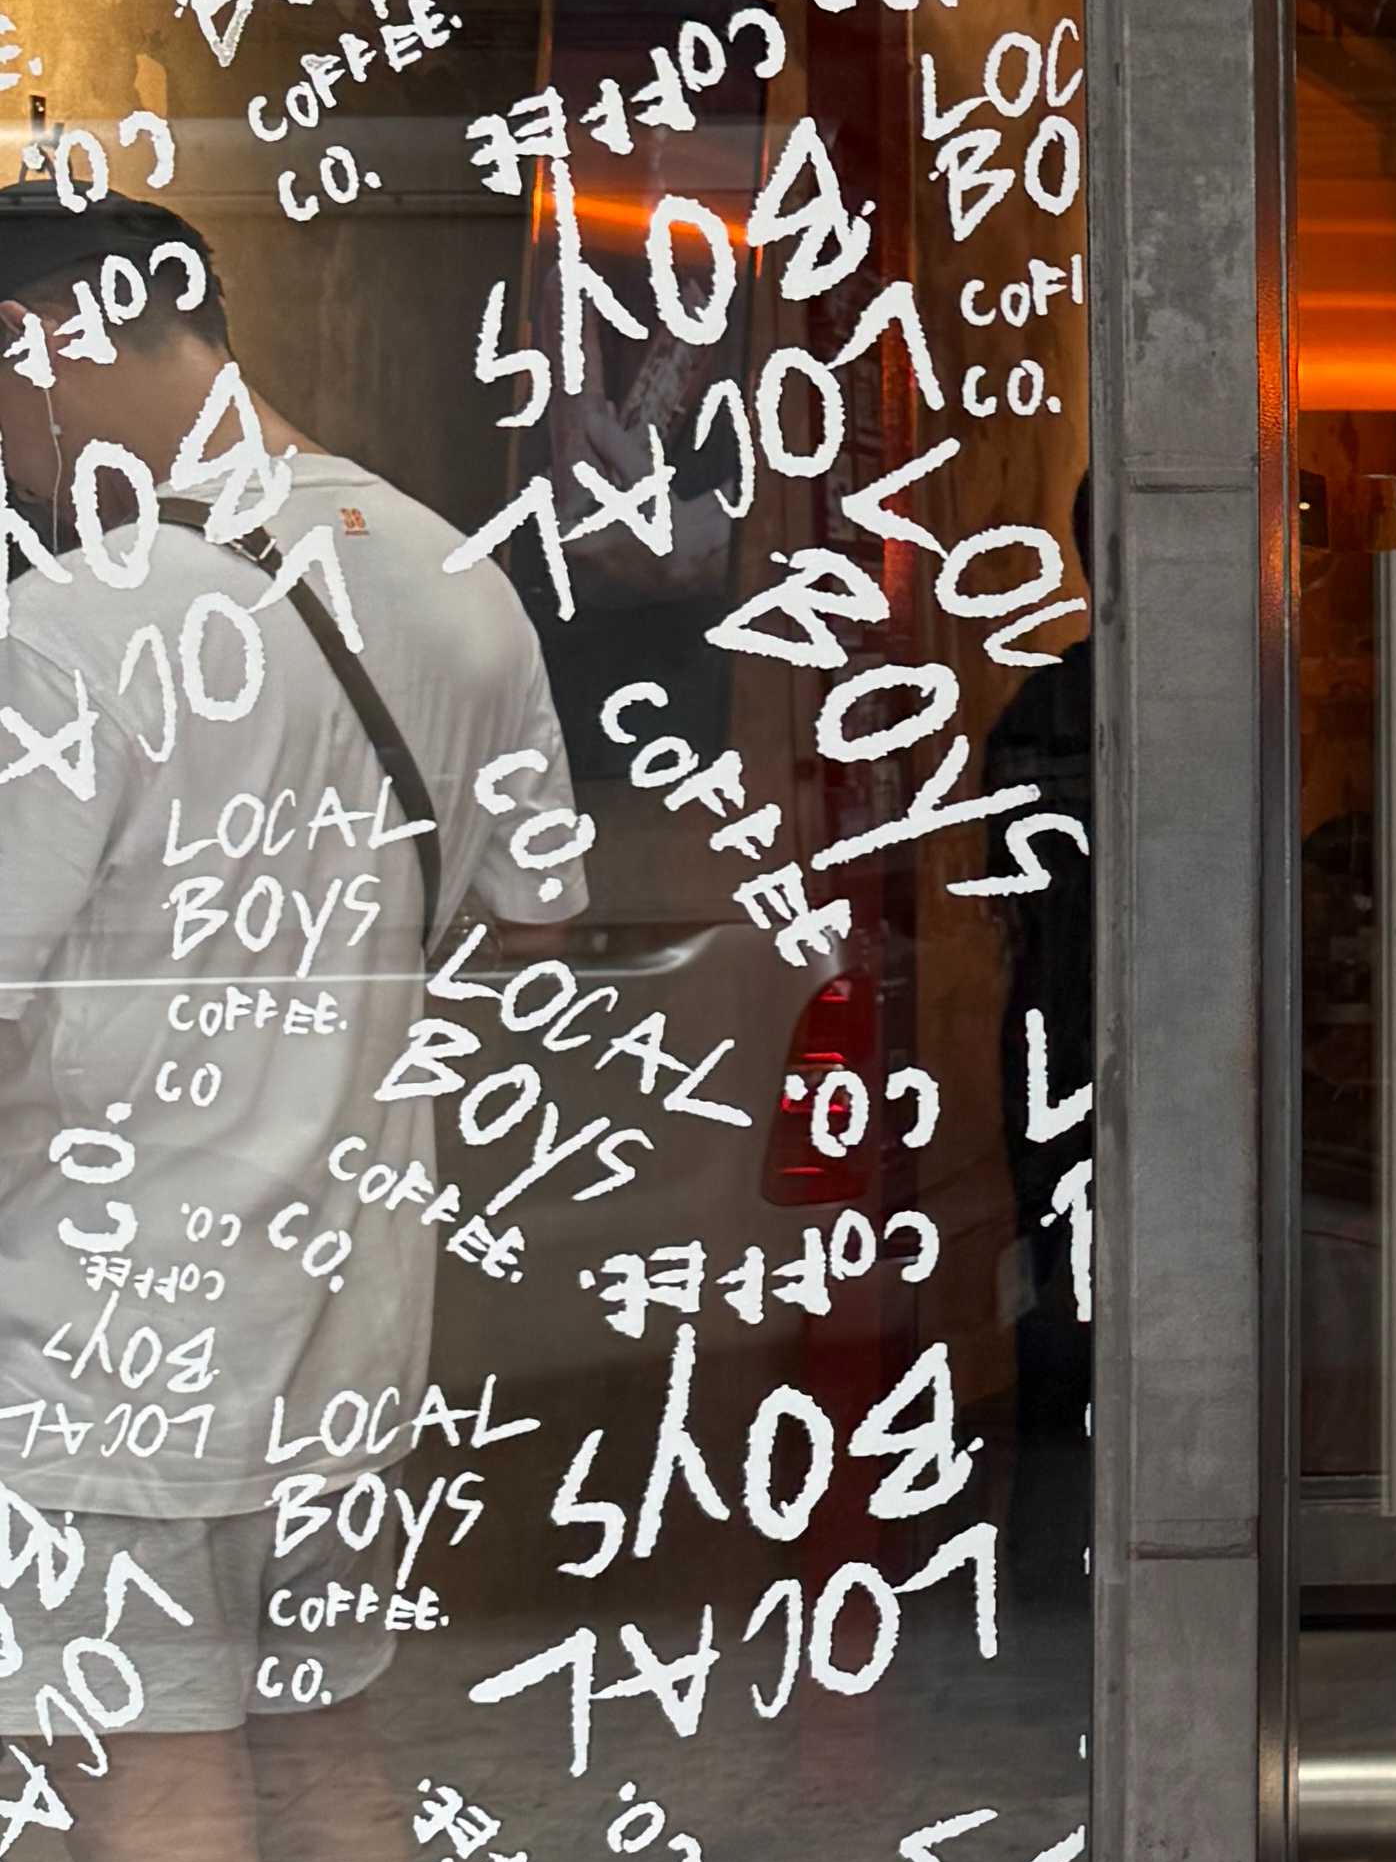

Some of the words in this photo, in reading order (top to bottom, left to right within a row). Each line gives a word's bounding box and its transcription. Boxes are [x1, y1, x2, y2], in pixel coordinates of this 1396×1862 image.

[465, 7, 787, 196] COFFEE
[277, 145, 382, 222] CO.
[474, 116, 877, 428] BOYS
[960, 253, 1083, 328] COF
[962, 359, 1062, 418] CO.
[441, 280, 946, 622] LOCAL
[704, 547, 1090, 897] BOYS
[161, 775, 437, 868] LOCAL
[473, 747, 597, 904] CO.
[599, 681, 852, 968] COFFEE
[161, 872, 382, 981] BOYS
[166, 985, 349, 1038] COFFEE.
[425, 923, 753, 1128] LOCAL
[154, 1060, 223, 1108] CO
[372, 1017, 655, 1217] BOYS
[784, 1066, 941, 1158] CO.
[48, 1101, 140, 1255] CO.
[179, 1201, 242, 1248] CO.
[327, 1135, 525, 1284] COFFEE.
[267, 1201, 353, 1294] CO.
[579, 1208, 940, 1339] COFFEE.
[0, 1398, 216, 1460] LOCAL
[263, 1373, 542, 1465] LOCAL
[550, 1322, 984, 1579] BOYS
[262, 1470, 485, 1591] BOYS
[268, 1580, 451, 1633] COFFEE.
[468, 1521, 999, 1778] LOCAL
[256, 1655, 333, 1706] CO.
